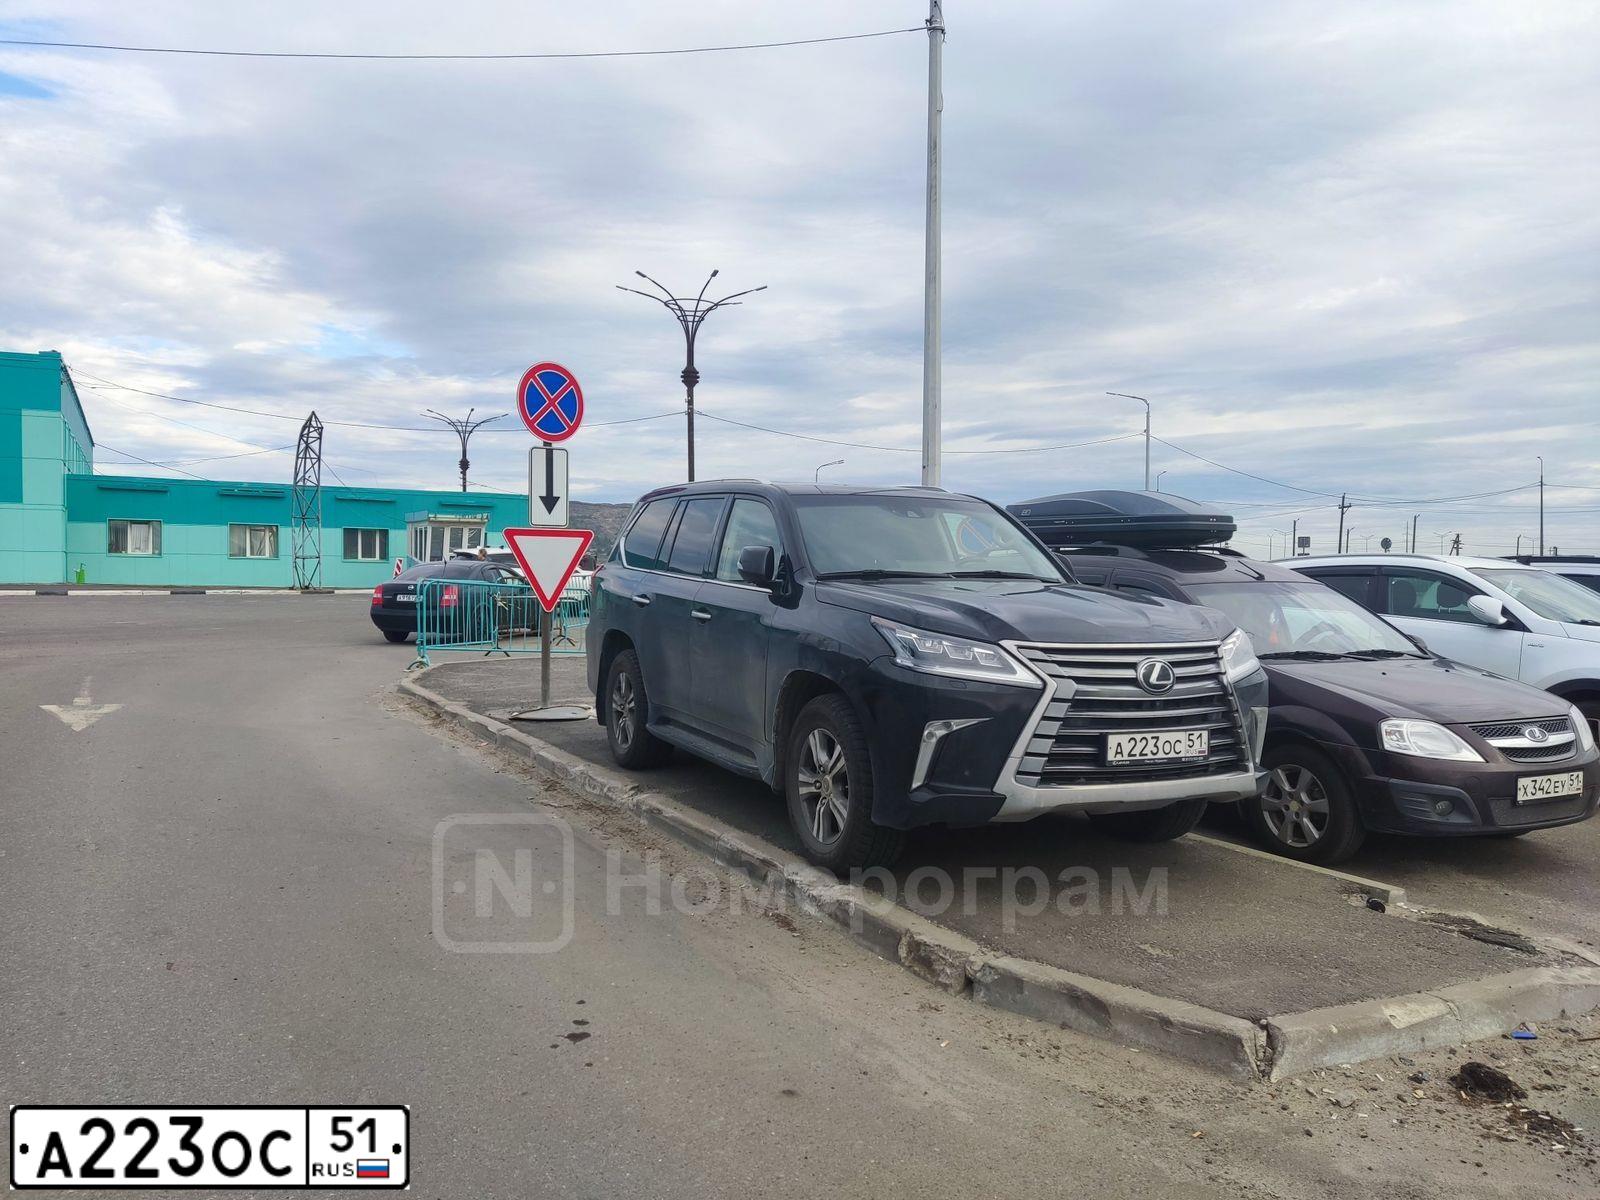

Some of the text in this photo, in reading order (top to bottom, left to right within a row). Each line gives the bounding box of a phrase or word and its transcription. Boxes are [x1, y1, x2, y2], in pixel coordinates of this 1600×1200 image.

[1113, 732, 1203, 758] А223ОС 51
[1569, 773, 1580, 787] 51
